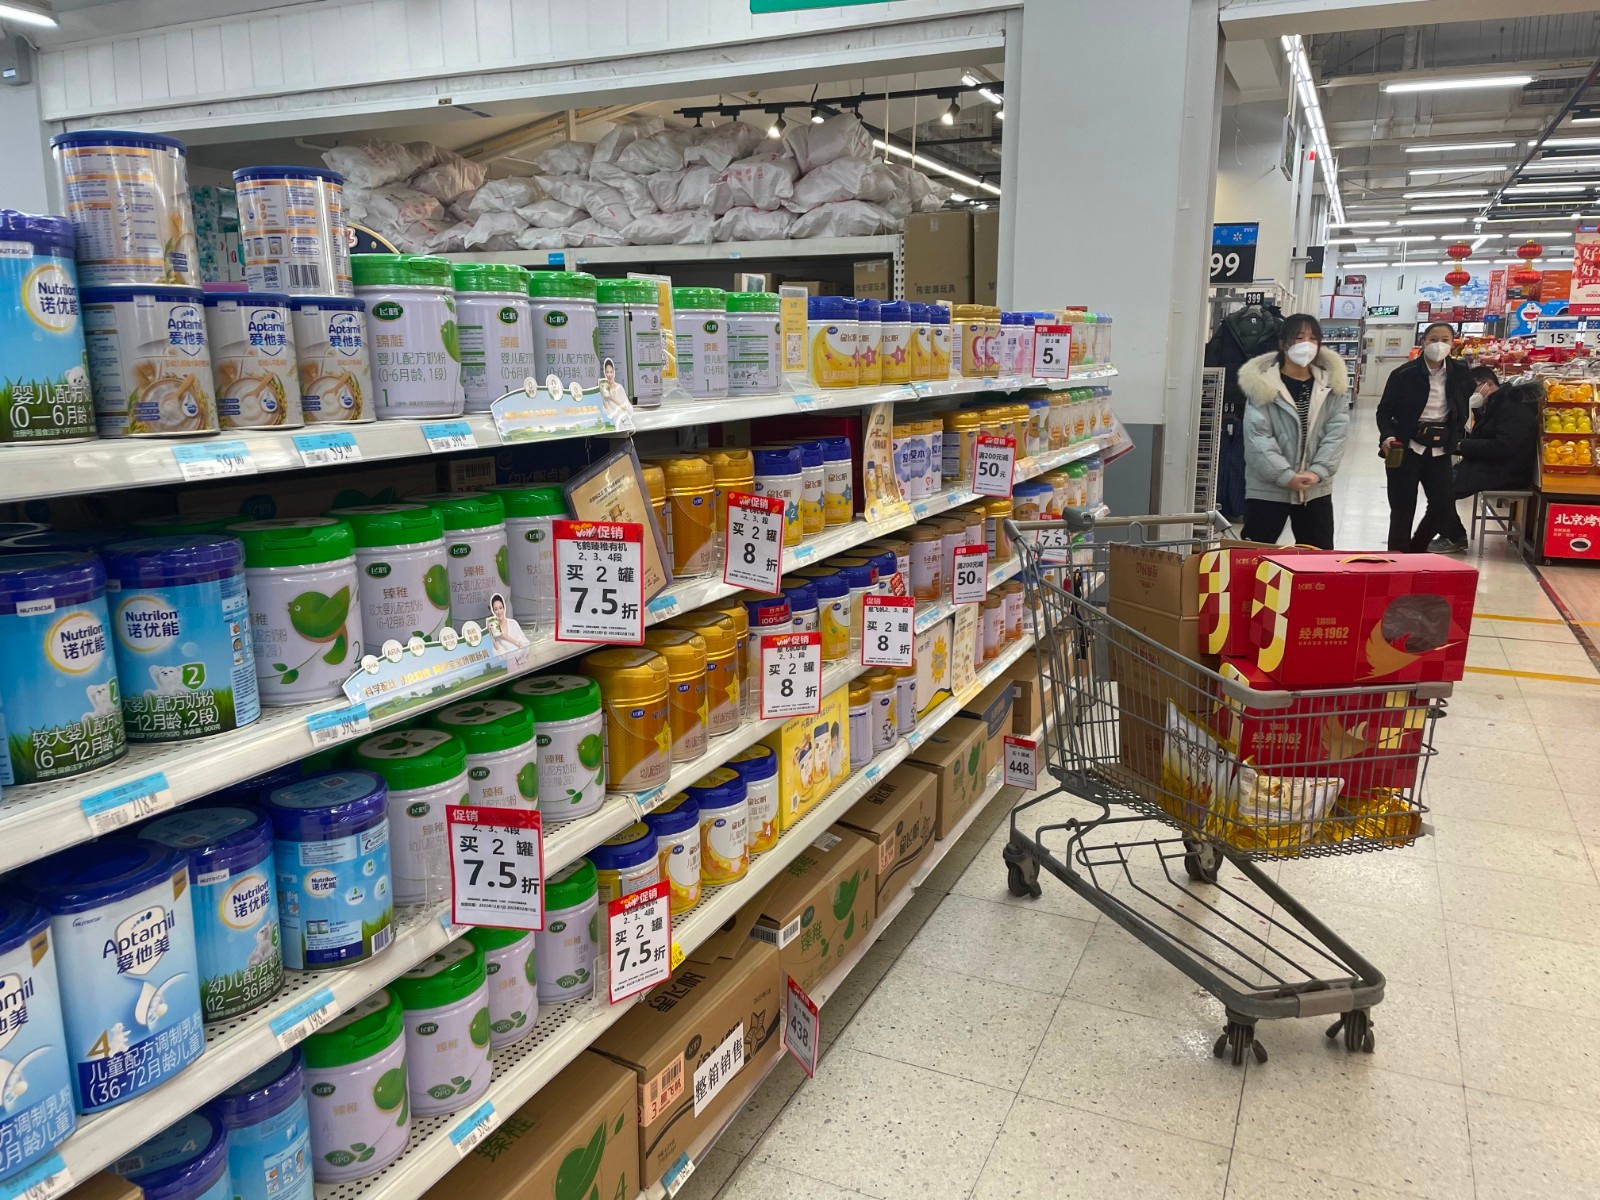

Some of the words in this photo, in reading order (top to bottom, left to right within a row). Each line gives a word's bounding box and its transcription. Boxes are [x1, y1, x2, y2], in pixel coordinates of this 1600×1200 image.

[1210, 252, 1241, 277] 99
[1247, 294, 1261, 304] 399
[248, 322, 285, 334] Aptamil
[329, 325, 360, 334] Aptamil
[169, 331, 205, 346] 爱他美
[250, 333, 287, 346] 爱他美
[330, 336, 362, 348] 爱他美
[377, 352, 446, 365] 婴儿配方奶粉
[1043, 347, 1054, 364] 5
[382, 389, 390, 407] 1
[979, 462, 999, 477] 50
[751, 498, 769, 509] 促销
[791, 508, 796, 518] 2
[598, 526, 624, 539] 促销
[733, 522, 744, 536] 买
[752, 526, 760, 540] 2
[766, 529, 777, 542] 罐
[572, 541, 628, 552] 飞鹤臻稚有机
[743, 543, 755, 564] 8
[766, 558, 777, 572] 折
[463, 565, 485, 577] 臻稚
[567, 564, 584, 581] 买
[596, 566, 607, 583] 2
[618, 567, 634, 583] 罐
[957, 571, 976, 585] 50
[383, 587, 408, 600] 臻稚
[19, 605, 52, 614] NUTRICIA
[570, 587, 618, 615] 7.5
[622, 602, 638, 620] 折
[125, 611, 177, 622] Nutrilon
[127, 621, 180, 638] 诺优能
[867, 621, 877, 631] 买
[885, 622, 892, 632] 2
[898, 623, 909, 632] 罐
[1299, 626, 1350, 639] 经典1962
[792, 635, 809, 645] 促销
[877, 635, 889, 651] 8
[900, 644, 910, 655] 折
[62, 638, 106, 660] 诺优能
[188, 667, 200, 685] 2
[769, 664, 780, 676] 买
[789, 663, 797, 674] 2
[804, 661, 814, 672] 罐
[780, 679, 794, 697] 8
[806, 686, 817, 697] 折
[545, 753, 564, 764] 臻稚
[1009, 761, 1029, 775] 448
[482, 787, 503, 798] 臻稚
[453, 809, 478, 821] 促销
[766, 824, 771, 836] 4
[460, 835, 478, 853] 买
[492, 839, 505, 855] 2
[517, 841, 534, 856] 罐
[311, 875, 337, 884] Nutrilon
[463, 859, 517, 888] 7.5
[522, 877, 539, 895] 折
[232, 880, 269, 903] Nutrilon
[311, 881, 337, 891] 诺优能
[640, 888, 658, 903] 促销
[234, 893, 270, 918] 诺优能
[103, 909, 175, 959] Aptamil
[615, 930, 626, 946] 买
[636, 924, 644, 939] 2
[116, 936, 170, 975] 爱他美
[617, 940, 652, 972] 7.5
[654, 945, 665, 961] 折
[649, 972, 706, 1013] 星飞帆
[791, 1015, 809, 1047] 438
[86, 1029, 111, 1058] 4
[695, 1037, 743, 1105] 整箱销售
